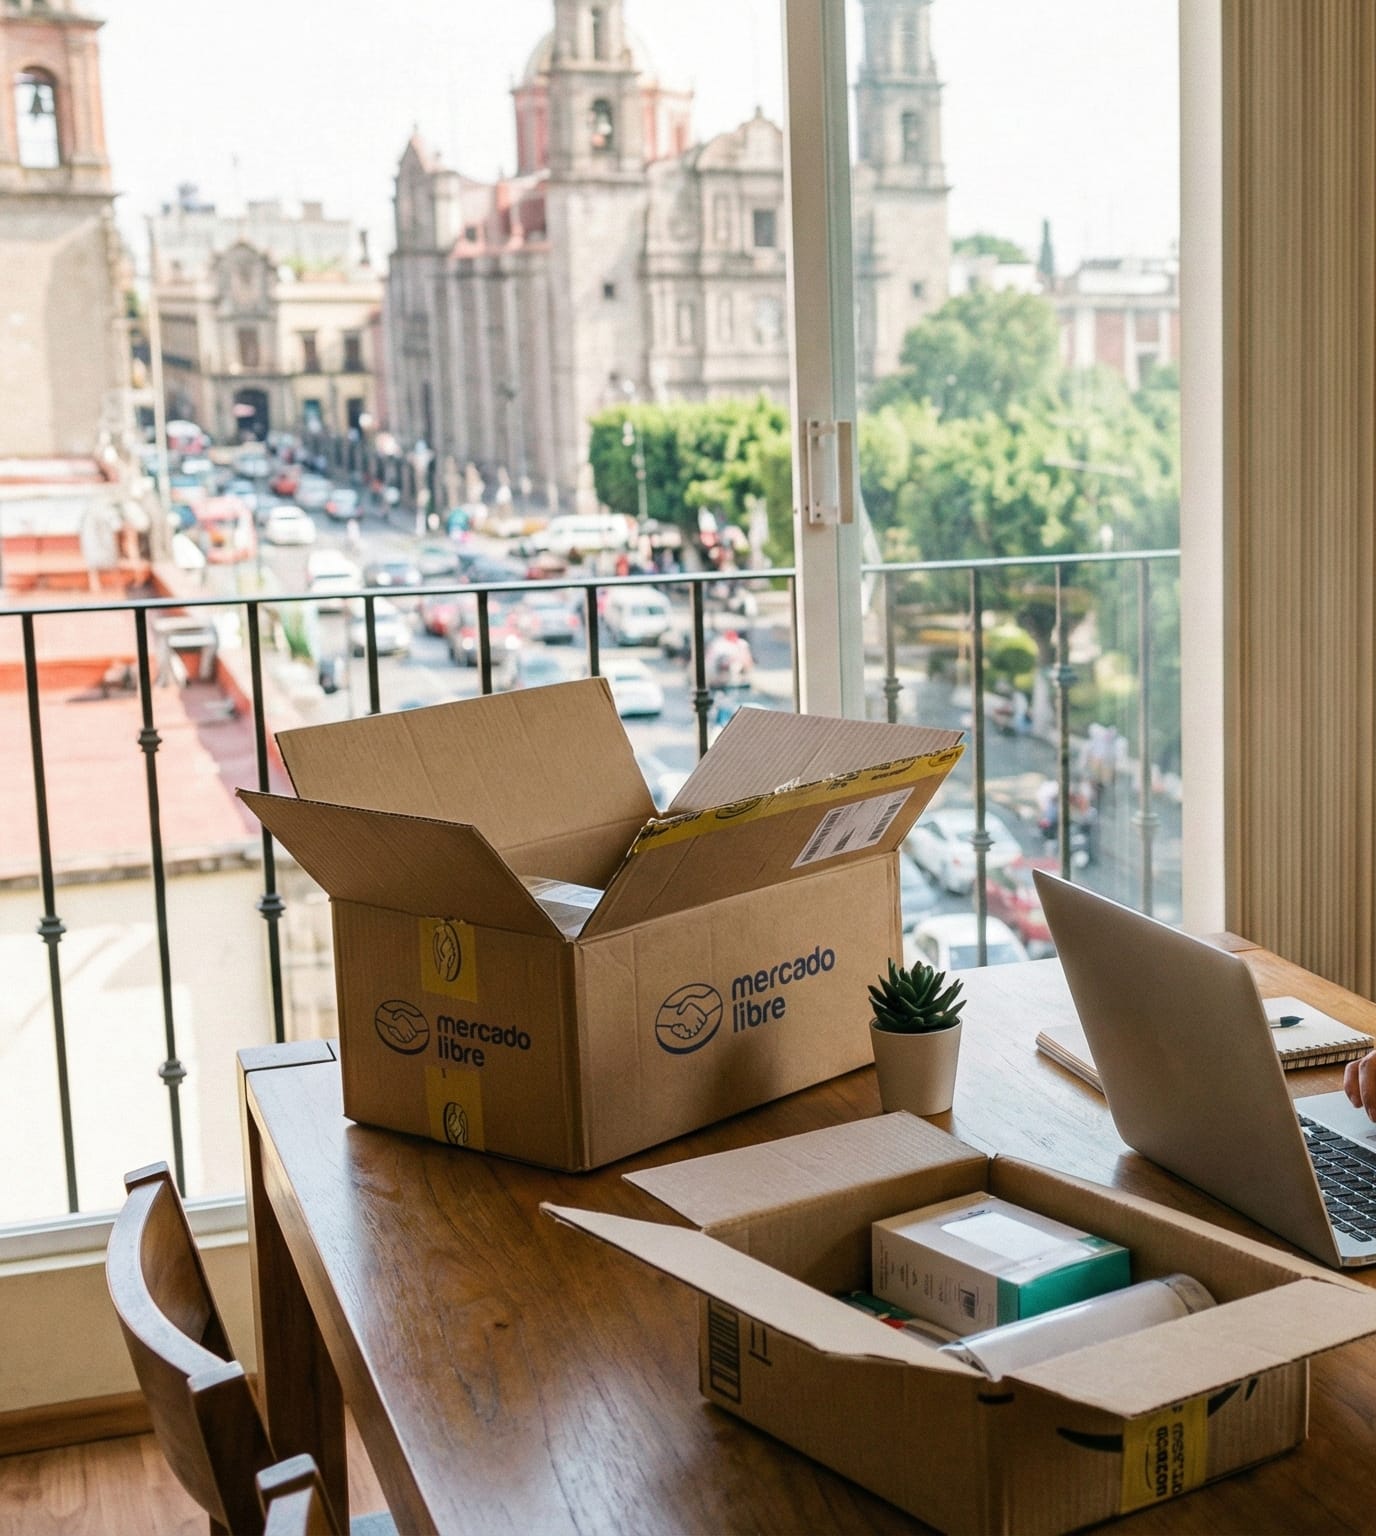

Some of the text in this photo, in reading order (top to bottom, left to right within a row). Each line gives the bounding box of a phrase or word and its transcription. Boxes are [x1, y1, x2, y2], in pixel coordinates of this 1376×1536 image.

[732, 945, 836, 1001] mercado
[436, 1004, 532, 1051] mercado
[733, 996, 787, 1033] libre
[437, 1035, 486, 1067] libre
